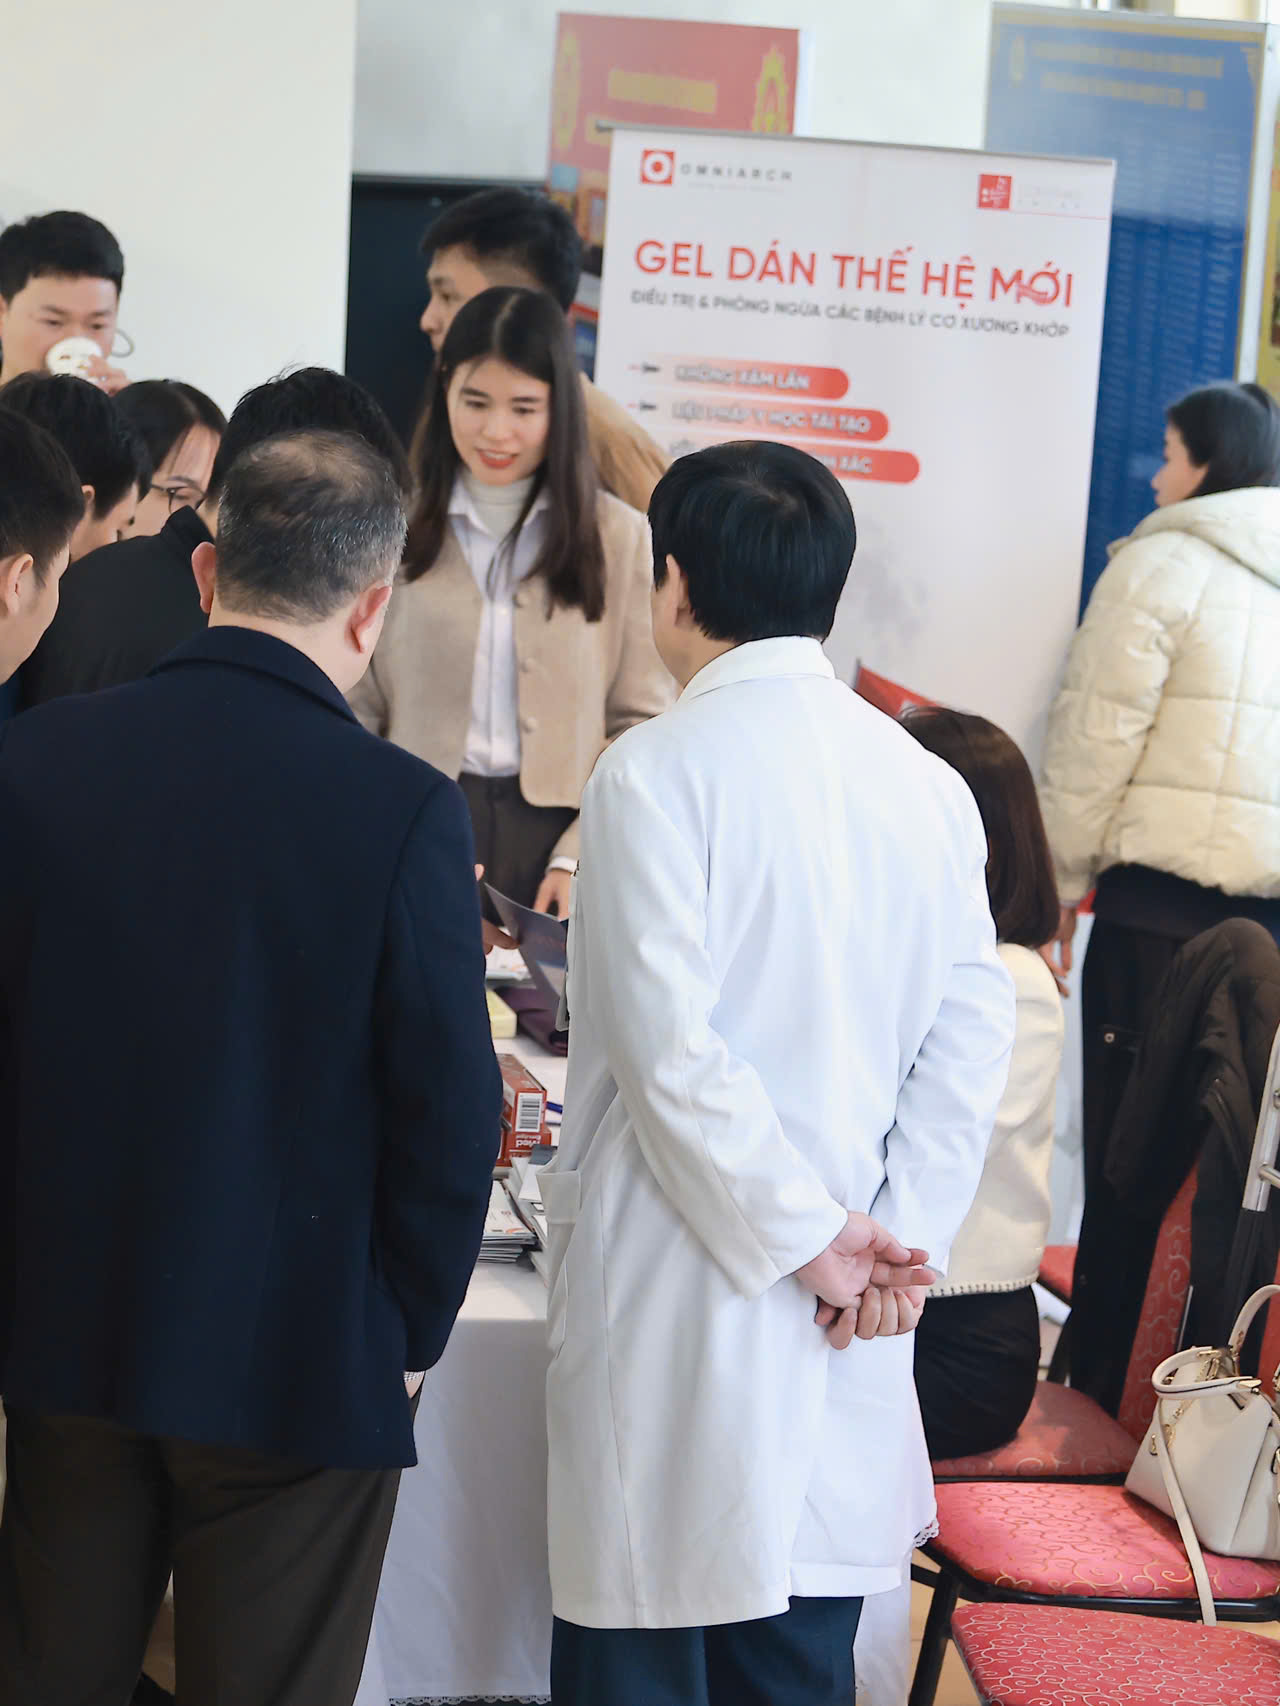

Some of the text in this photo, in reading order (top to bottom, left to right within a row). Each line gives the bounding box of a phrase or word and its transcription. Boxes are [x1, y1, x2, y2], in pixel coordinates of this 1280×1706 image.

[634, 240, 1073, 309] GEL DÁN THẾ HỆ MỚI
[672, 293, 696, 310] TRỊ
[699, 295, 709, 309] &
[713, 294, 769, 314] PHÒNG
[825, 302, 860, 321] CÁC
[864, 305, 904, 324] BỆNH
[908, 309, 925, 326] LÝ
[929, 313, 956, 329] CƠ
[960, 316, 1019, 334] XƯƠNG
[1024, 319, 1069, 338] KHỚP
